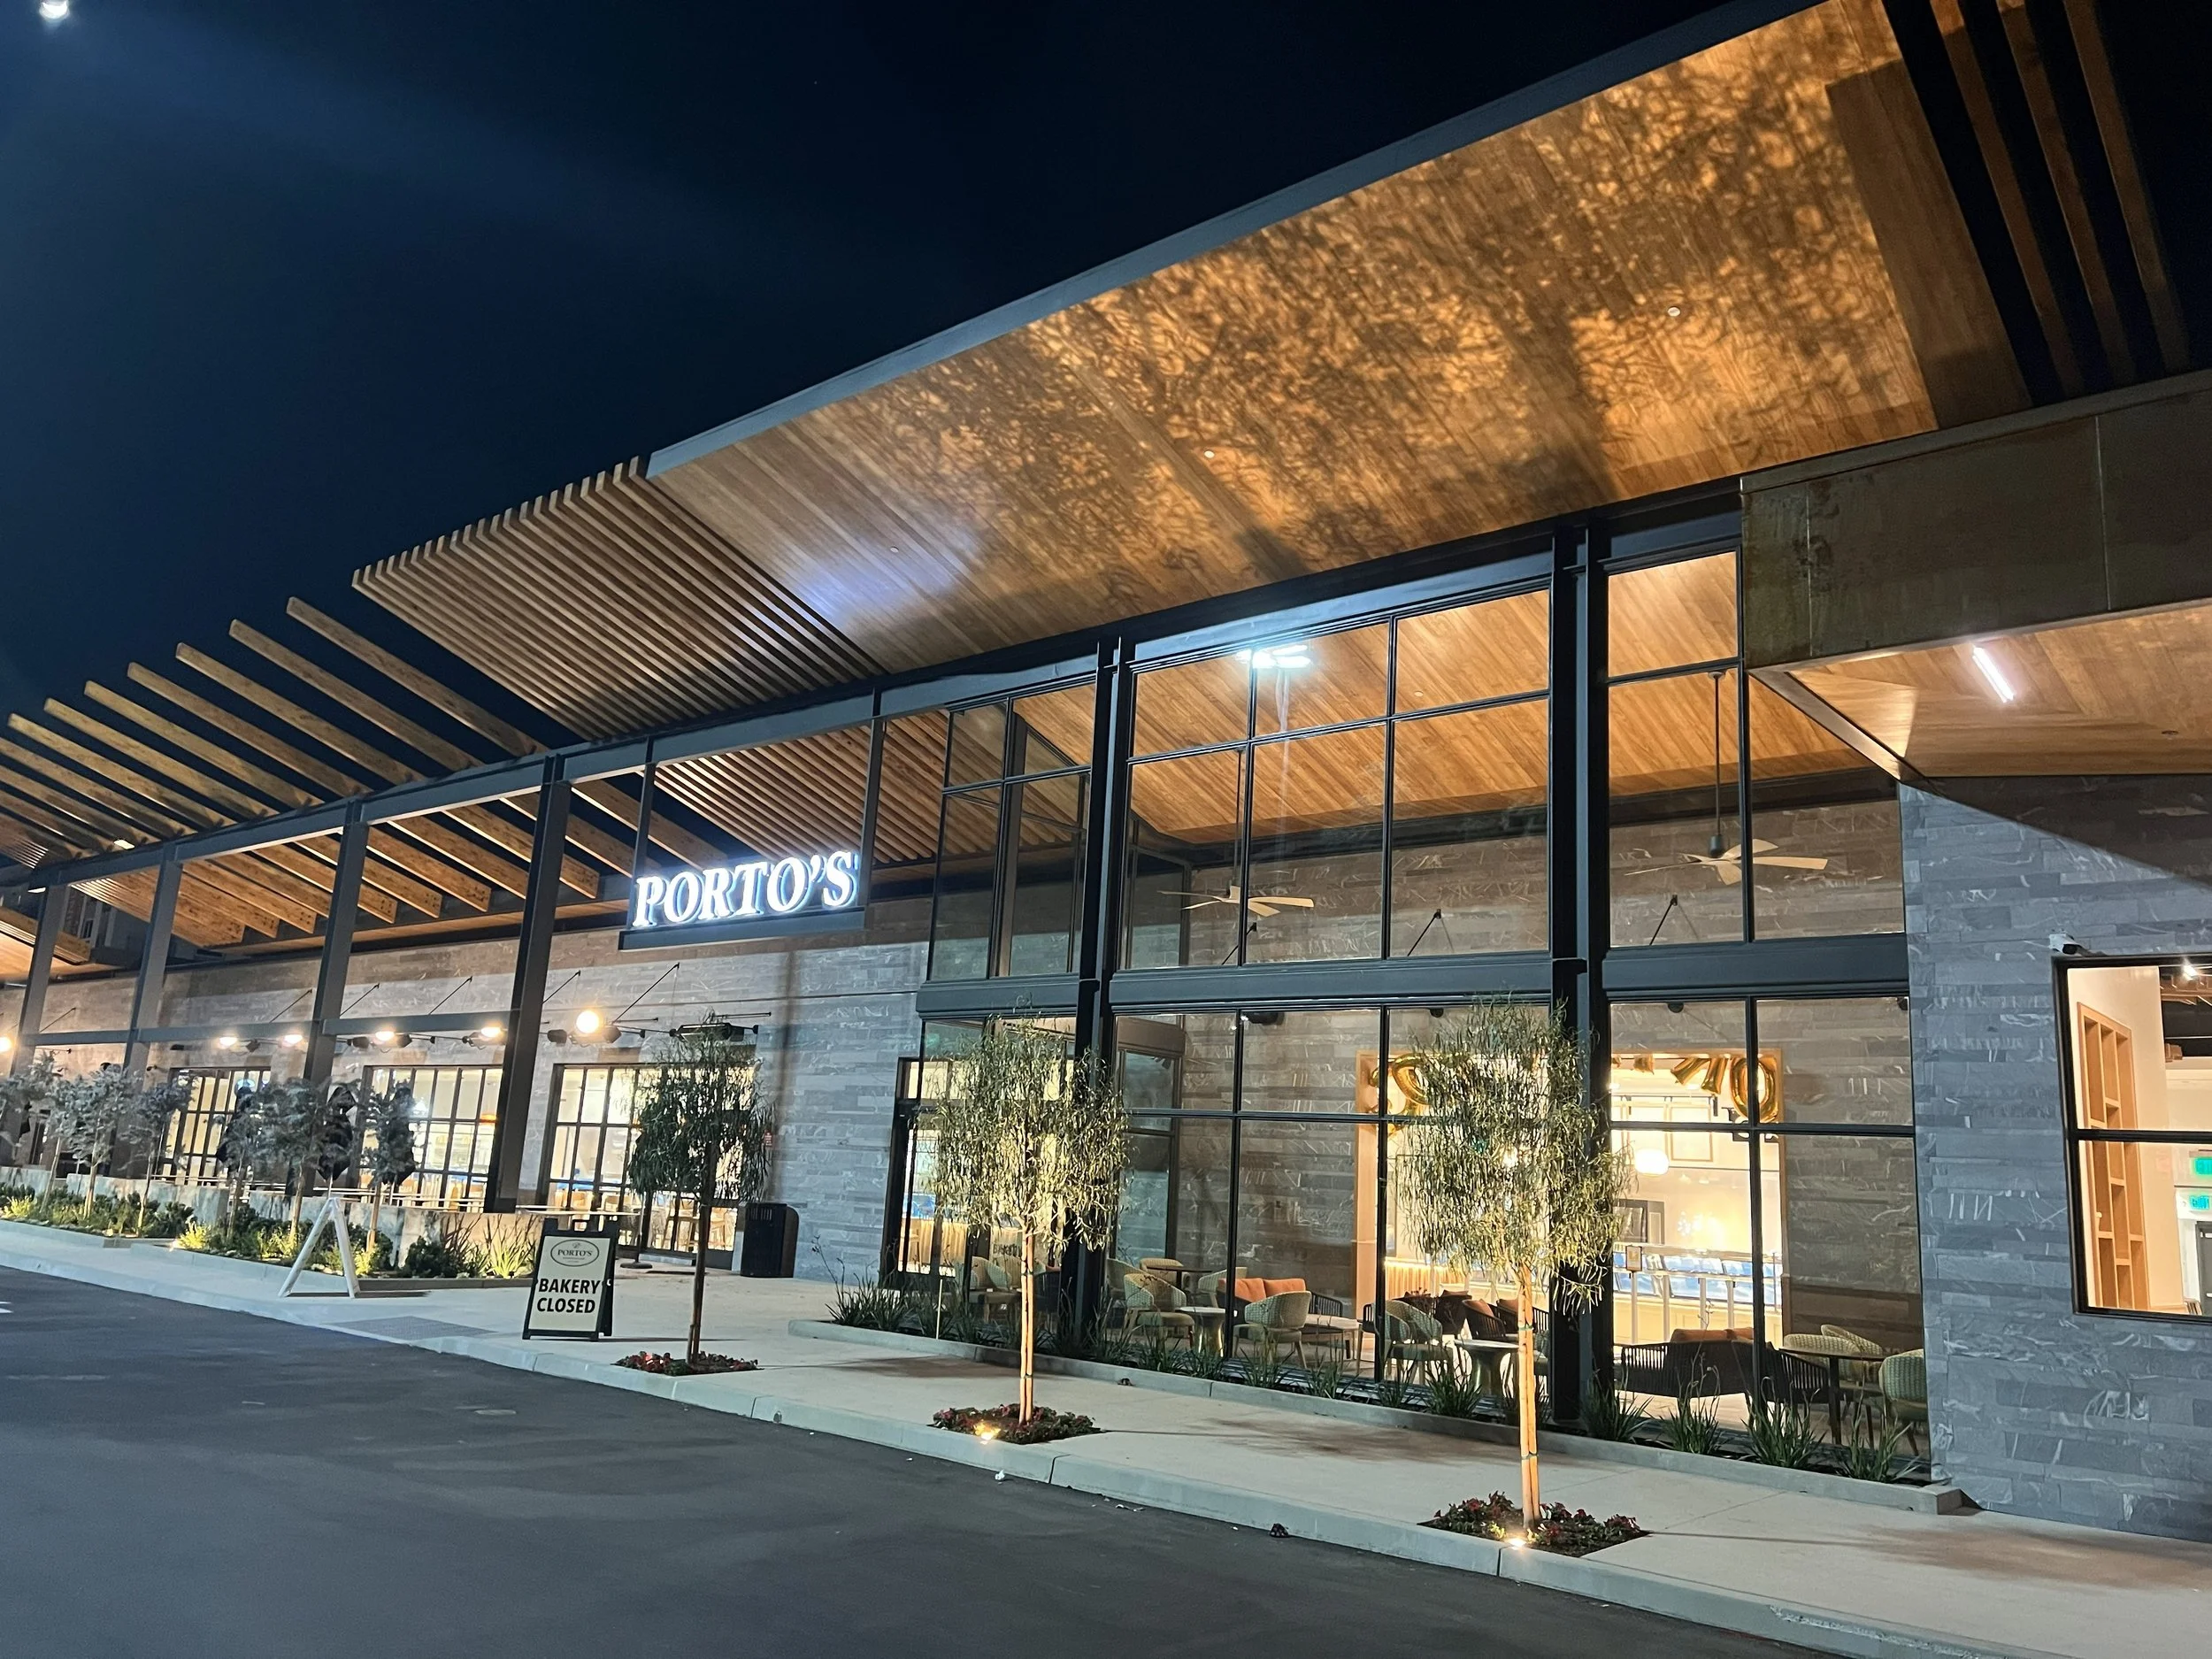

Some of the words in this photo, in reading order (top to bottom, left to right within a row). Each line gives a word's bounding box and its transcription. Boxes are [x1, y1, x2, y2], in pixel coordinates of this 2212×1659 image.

[633, 850, 858, 927] PORTO'S
[539, 1279, 600, 1294] BAKERY
[537, 1298, 595, 1313] CLOSED
